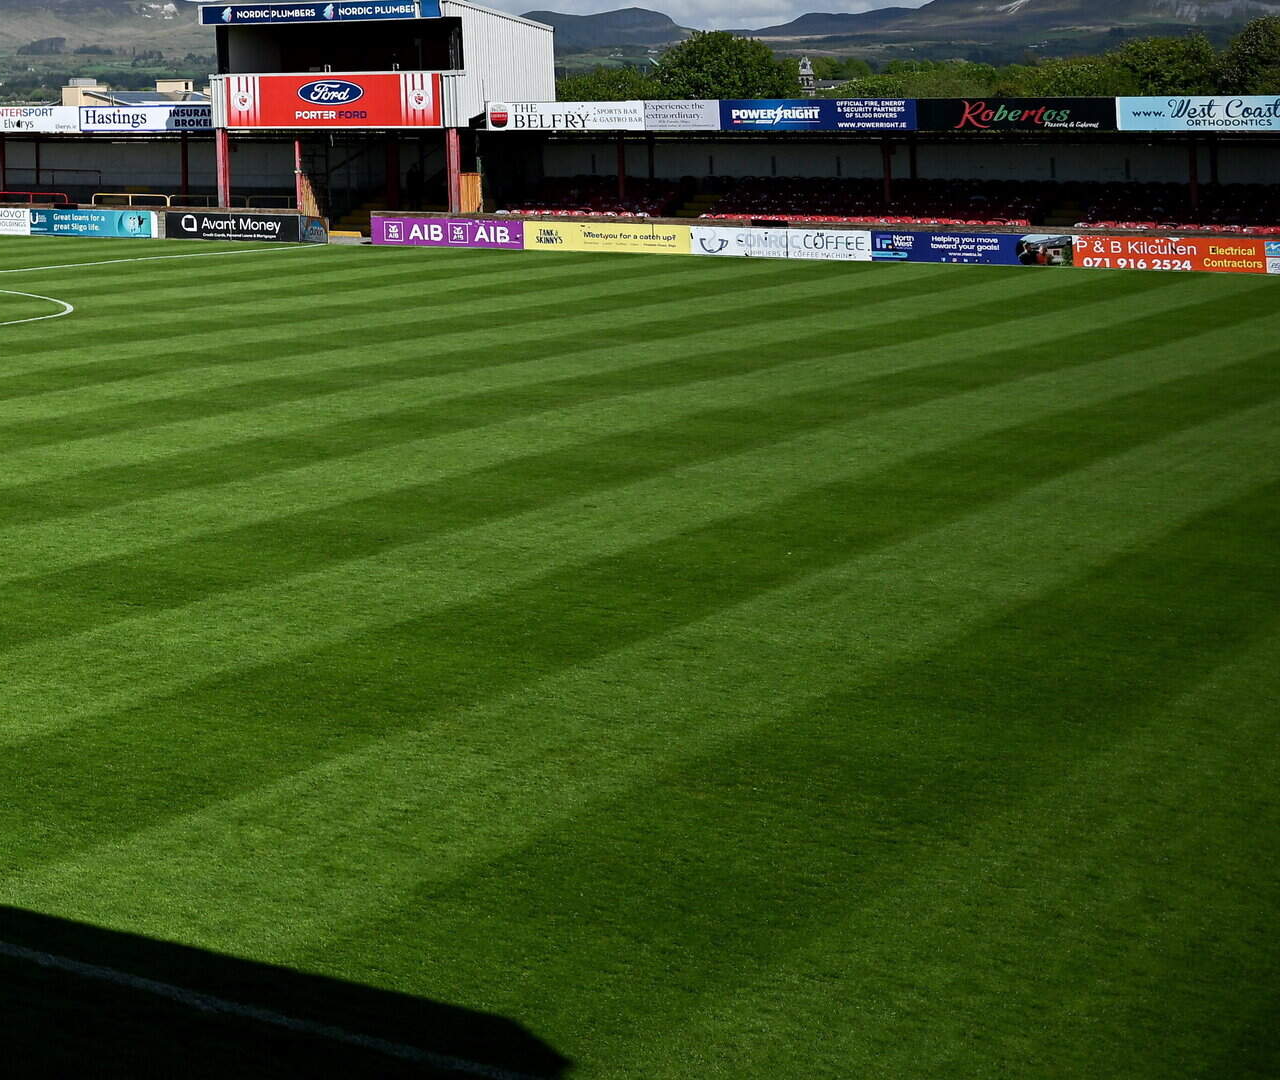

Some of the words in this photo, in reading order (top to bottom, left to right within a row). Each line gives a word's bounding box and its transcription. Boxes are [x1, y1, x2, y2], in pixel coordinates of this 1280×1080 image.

[237, 9, 270, 20] NORDIC
[271, 7, 316, 18] PLUMBERS
[338, 6, 373, 16] NORDIC
[310, 83, 350, 101] Ford
[513, 103, 537, 113] THE
[644, 102, 690, 111] Experience
[691, 102, 705, 110] the
[1132, 110, 1166, 118] www.
[1167, 98, 1216, 119] West
[85, 109, 147, 127] Hastings
[295, 110, 336, 120] PORTER
[338, 110, 368, 119] FORD
[645, 111, 704, 121] extraordinary.
[513, 113, 589, 129] BELFRY
[1186, 117, 1273, 127] ORTHODONTICS
[53, 213, 71, 221] Great
[72, 213, 89, 221] loans
[90, 213, 100, 222] for
[53, 222, 70, 231] great
[71, 222, 87, 231] Sligo
[88, 223, 100, 231] life.
[201, 216, 236, 231] Avant
[239, 217, 282, 234] Money
[408, 224, 444, 241] AIB
[474, 225, 511, 243] AIB
[538, 228, 554, 236] TANK
[535, 236, 563, 245] SKINNY'S
[639, 233, 662, 241] catch
[662, 234, 677, 242] up?
[803, 233, 865, 251] COFFEE
[892, 234, 915, 242] North
[931, 235, 960, 244] Helping
[958, 244, 975, 252] your
[976, 243, 1000, 252] goals!
[1075, 240, 1088, 253] P
[1093, 240, 1105, 253] &
[1110, 240, 1122, 254] B
[1128, 241, 1198, 256] Kilcullen
[1208, 245, 1256, 257] Electrical
[792, 250, 819, 259] COFFEE
[1082, 257, 1111, 269] 071
[1116, 258, 1148, 270] 916
[1151, 258, 1193, 271] 2524
[1203, 257, 1264, 269] Contractors
